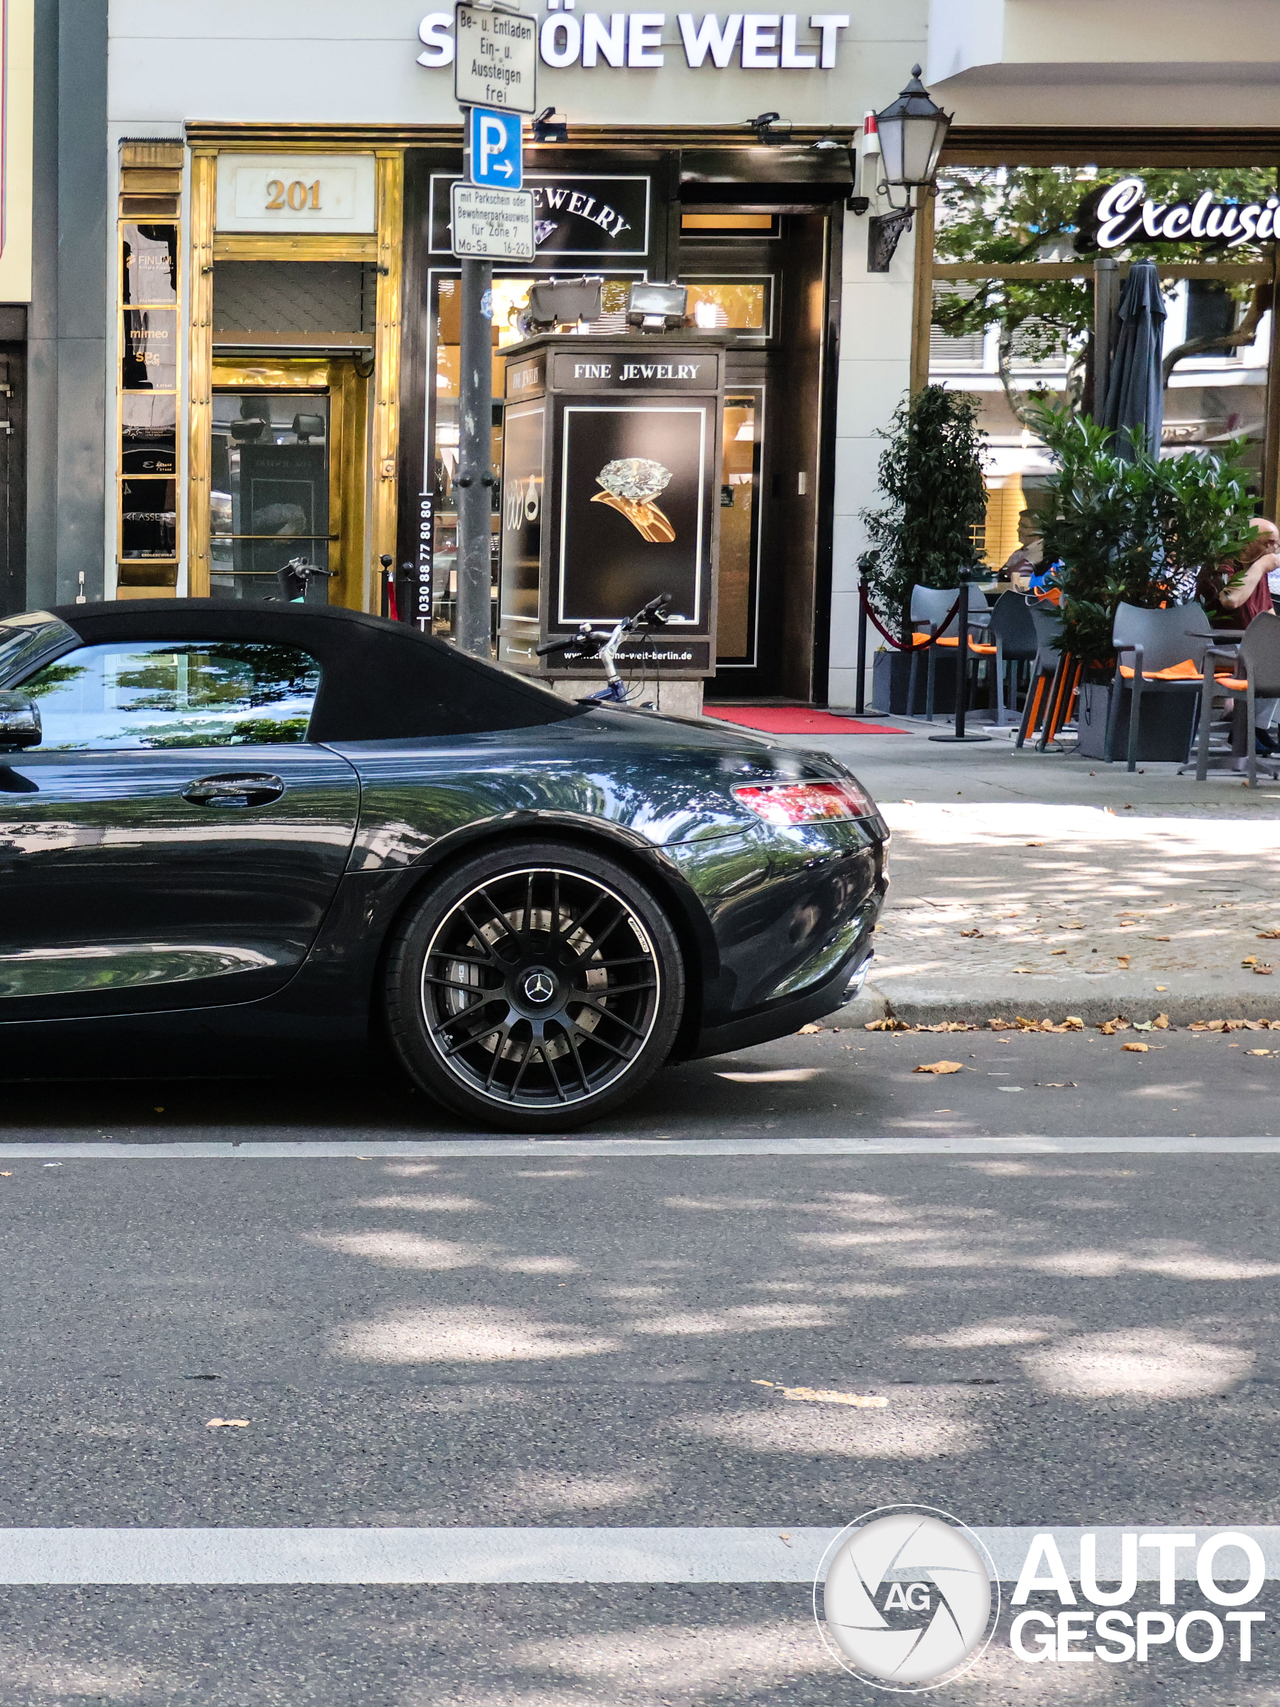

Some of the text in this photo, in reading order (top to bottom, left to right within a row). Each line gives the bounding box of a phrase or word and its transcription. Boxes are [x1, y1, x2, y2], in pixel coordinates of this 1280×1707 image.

[416, 0, 850, 69] SÖNE WELT
[460, 10, 532, 40] Be- u. Entladen
[480, 37, 512, 60] Ein- u.
[471, 58, 521, 86] Aussteigen
[485, 84, 507, 103] frei
[480, 115, 508, 176] P
[265, 179, 322, 211] 201
[460, 191, 527, 207] mit Parkschein oder
[457, 206, 530, 224] Bewohnerparkausweis
[532, 187, 632, 239] EWELRY
[471, 224, 519, 238] für Zone 7
[458, 238, 530, 255] Mo-Sa 16-22h
[130, 327, 169, 339] mimeo
[574, 364, 700, 381] FINE JEWELRY
[419, 501, 431, 612] 030 88 77 80 80
